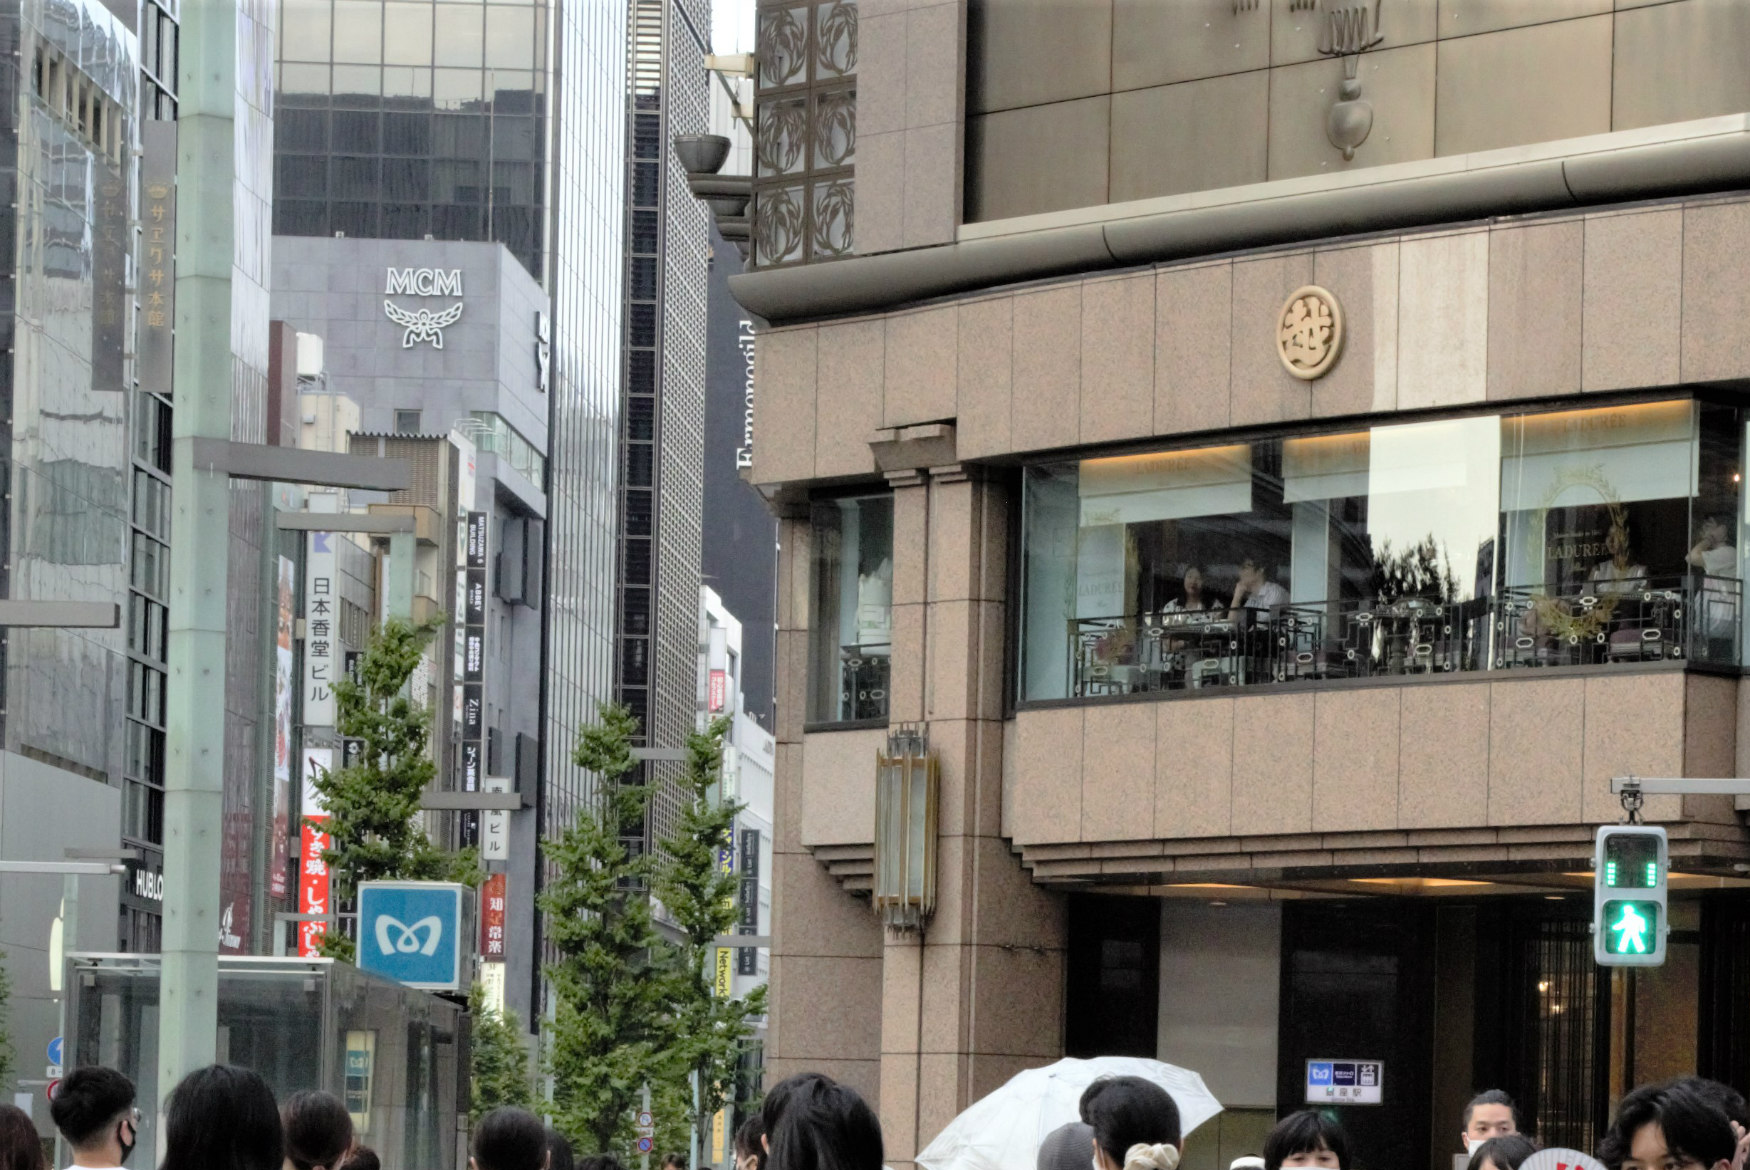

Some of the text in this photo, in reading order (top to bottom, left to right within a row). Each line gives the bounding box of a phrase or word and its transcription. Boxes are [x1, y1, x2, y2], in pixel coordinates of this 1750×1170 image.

[385, 267, 463, 296] MCM
[474, 583, 482, 611] ABBEY
[311, 577, 331, 702] 日本香堂ビル
[468, 698, 479, 726] Zina
[718, 950, 729, 994] Network
